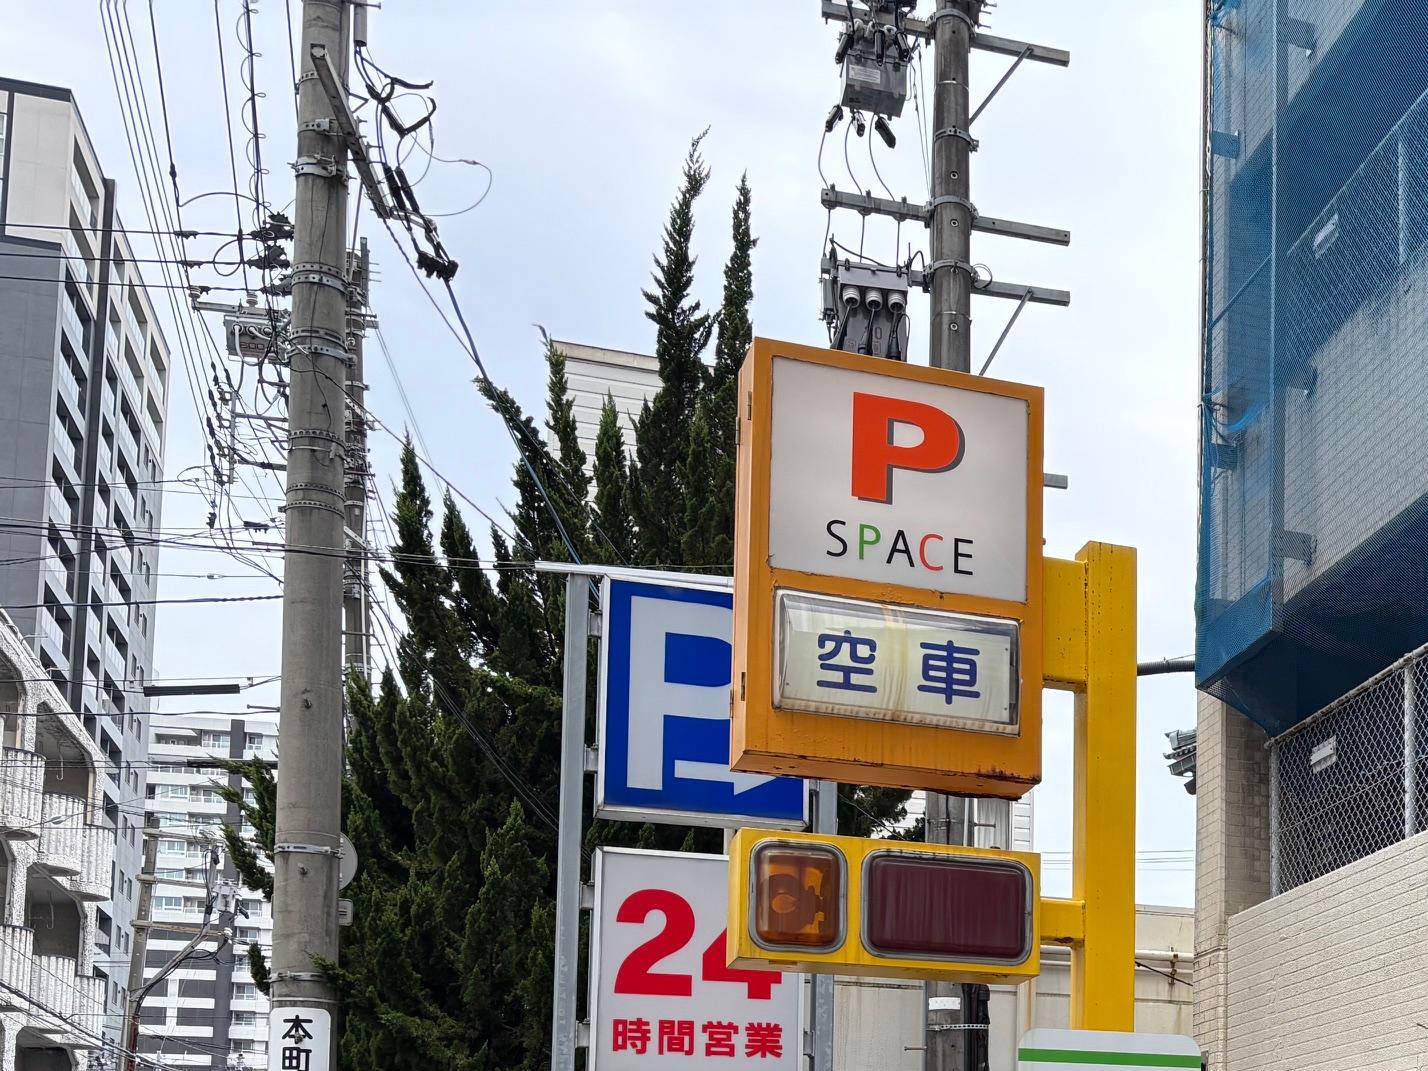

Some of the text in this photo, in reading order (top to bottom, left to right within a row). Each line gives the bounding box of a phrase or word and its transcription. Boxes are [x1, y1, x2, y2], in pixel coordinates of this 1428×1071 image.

[851, 391, 965, 505] P
[825, 519, 974, 576] SPACE
[627, 595, 733, 791] P
[816, 629, 981, 705] 空車
[612, 1017, 783, 1058] 時間営業
